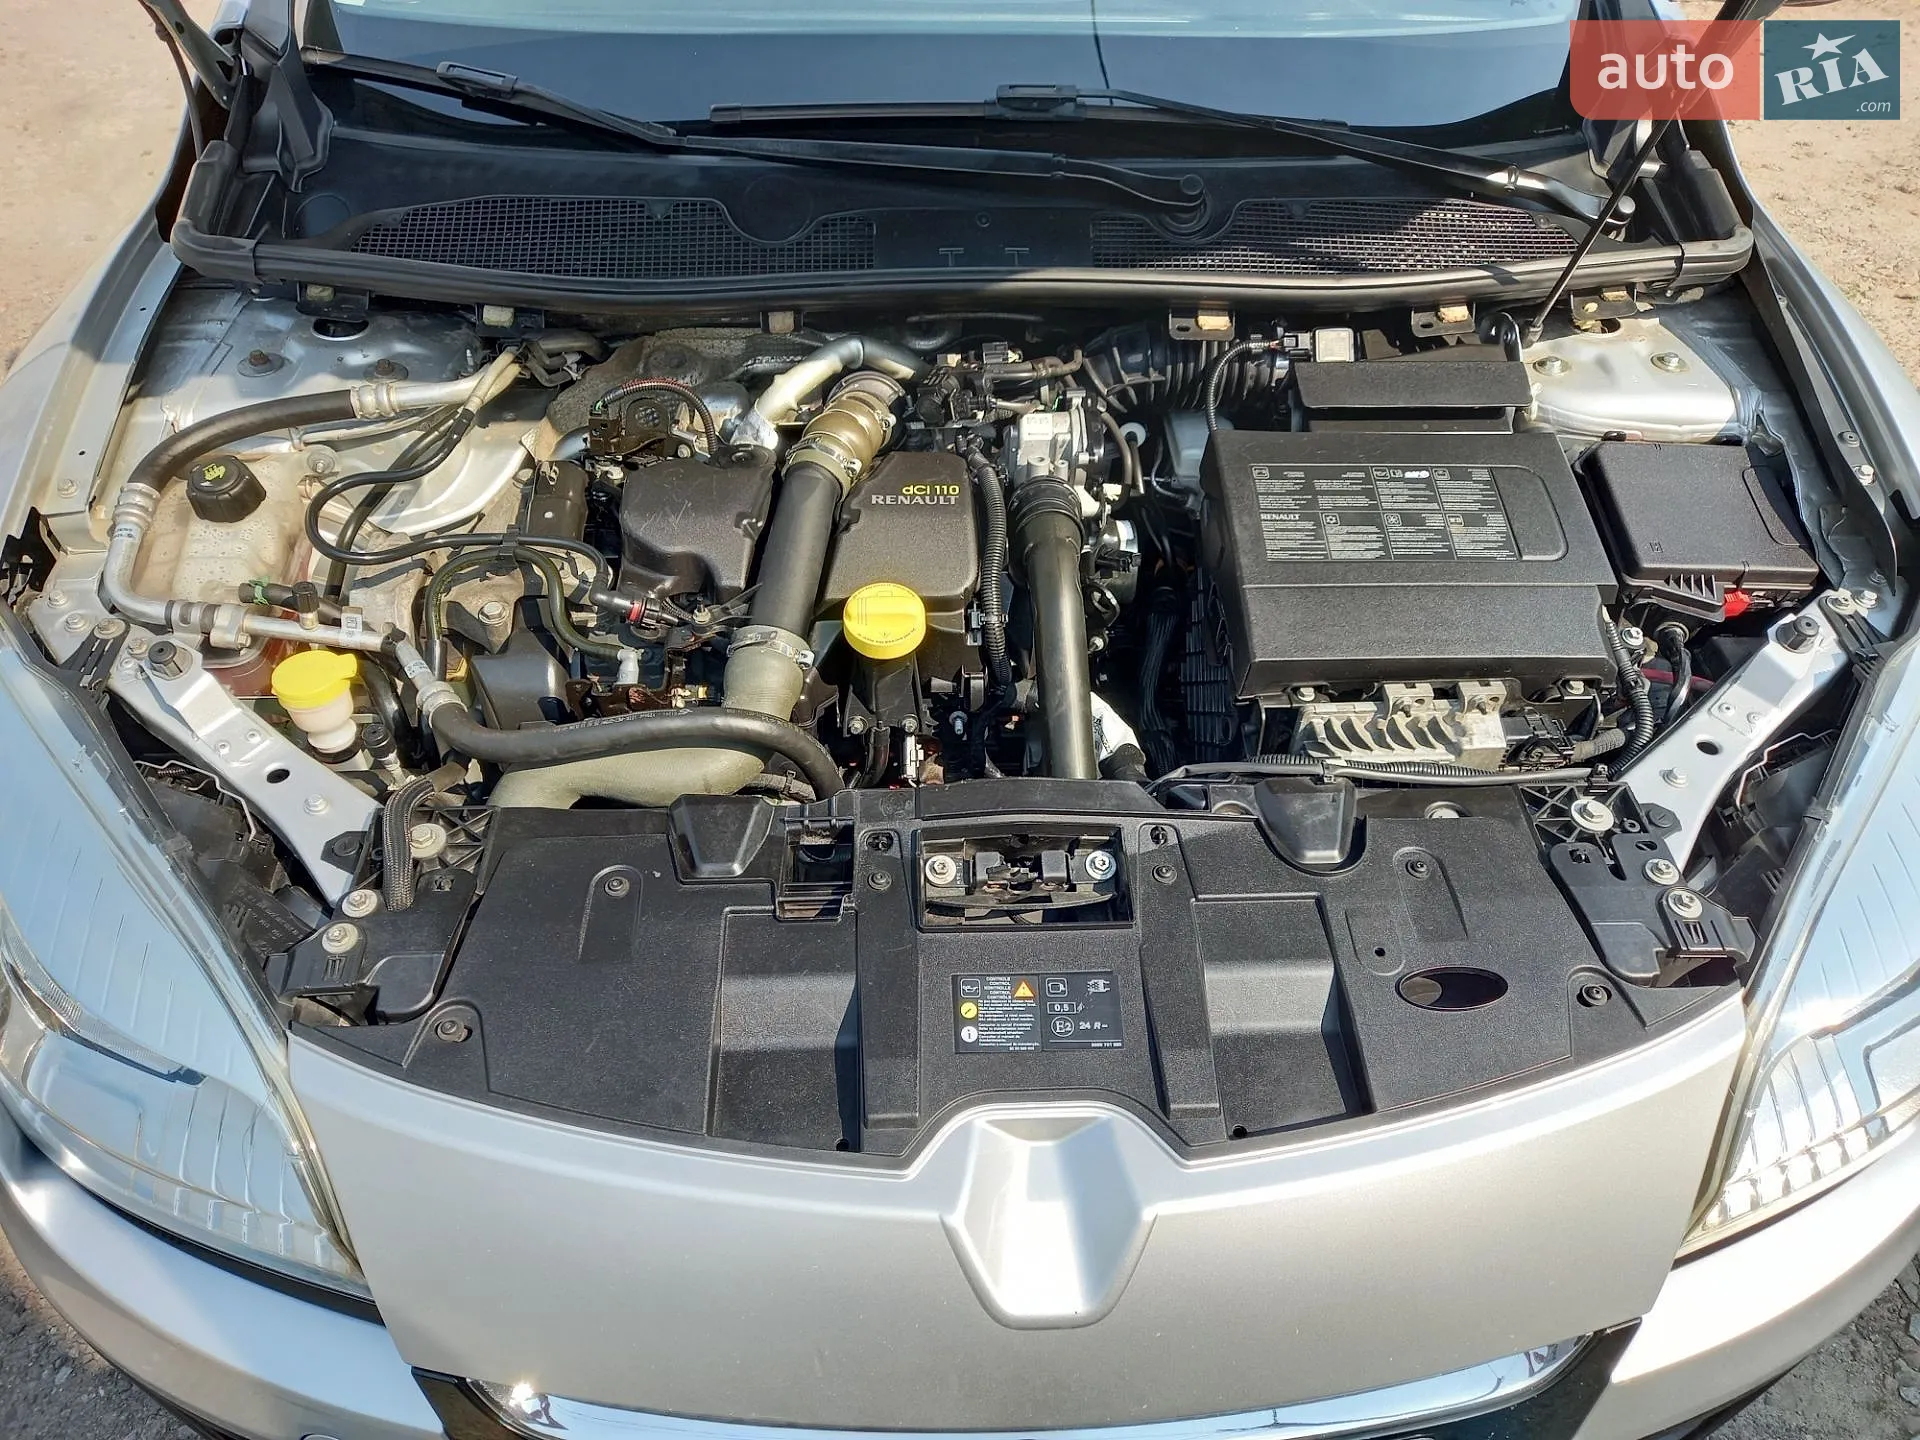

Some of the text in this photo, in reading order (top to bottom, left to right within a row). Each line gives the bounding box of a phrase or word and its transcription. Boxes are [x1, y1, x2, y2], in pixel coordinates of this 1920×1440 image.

[934, 485, 960, 495] 110
[871, 495, 960, 505] RENAULT
[1054, 1004, 1069, 1012] 0,5
[1055, 1020, 1072, 1033] E2
[1079, 1021, 1091, 1030] 24
